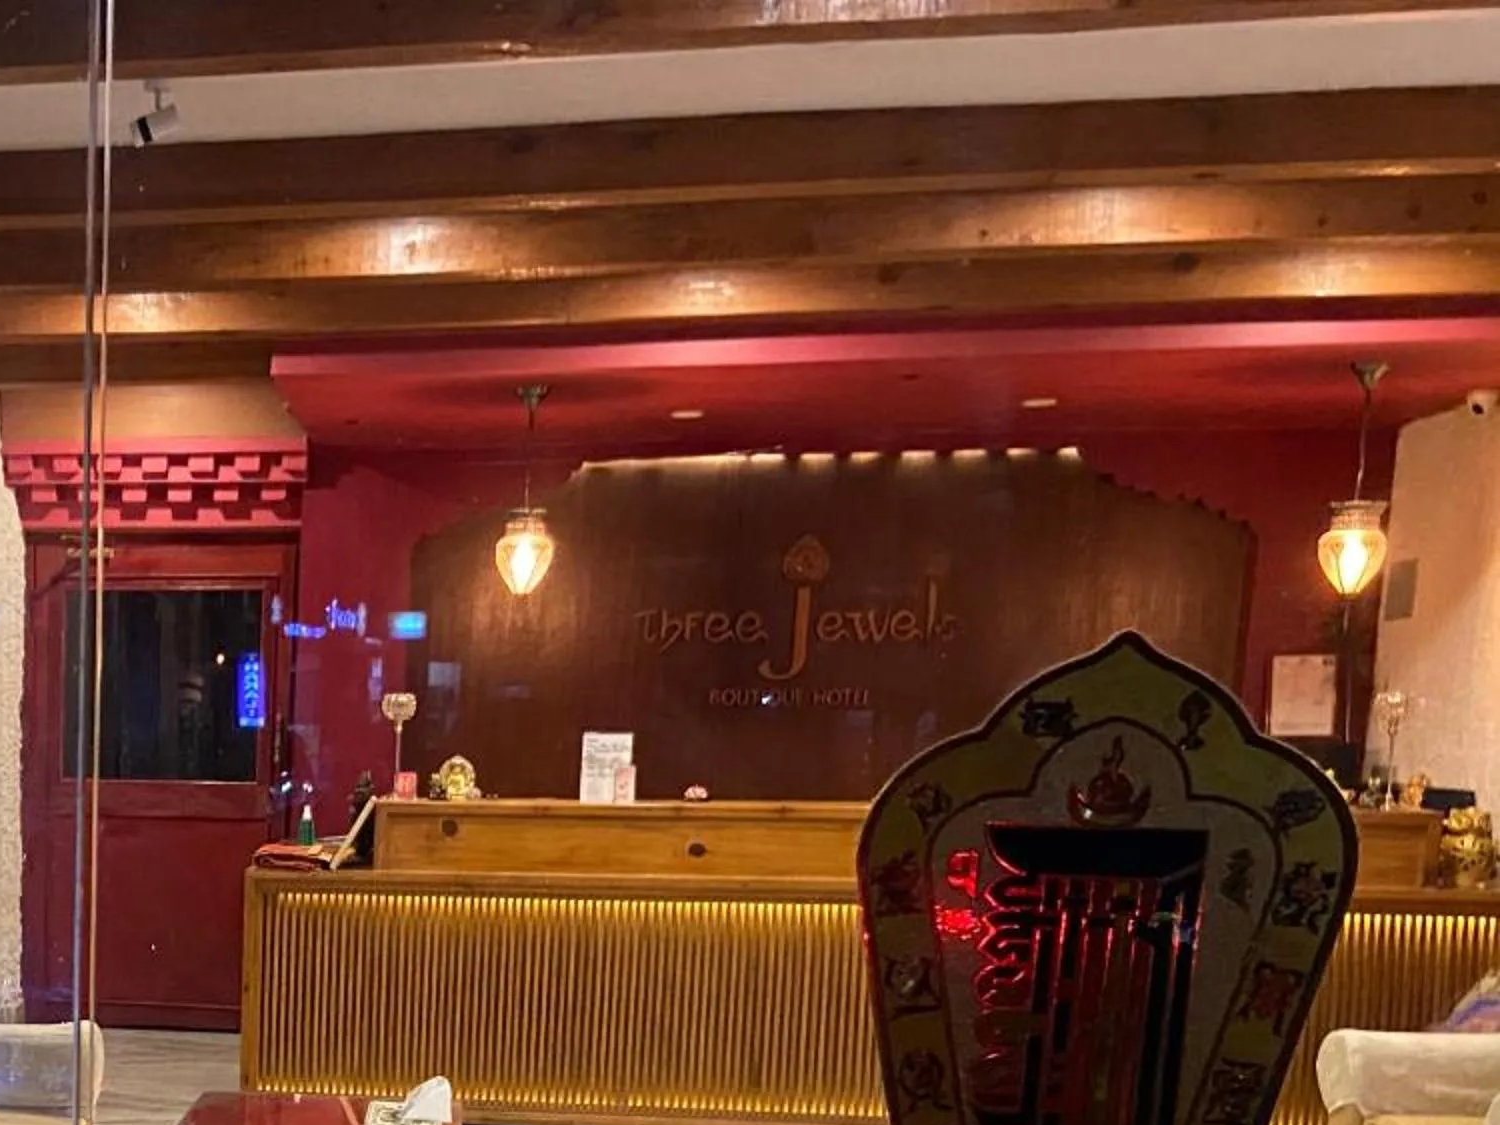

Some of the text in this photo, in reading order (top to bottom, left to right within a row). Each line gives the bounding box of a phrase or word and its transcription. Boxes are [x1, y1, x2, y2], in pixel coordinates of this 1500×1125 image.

[633, 575, 964, 681] Three Jewels
[708, 686, 804, 707] BOUTQUE
